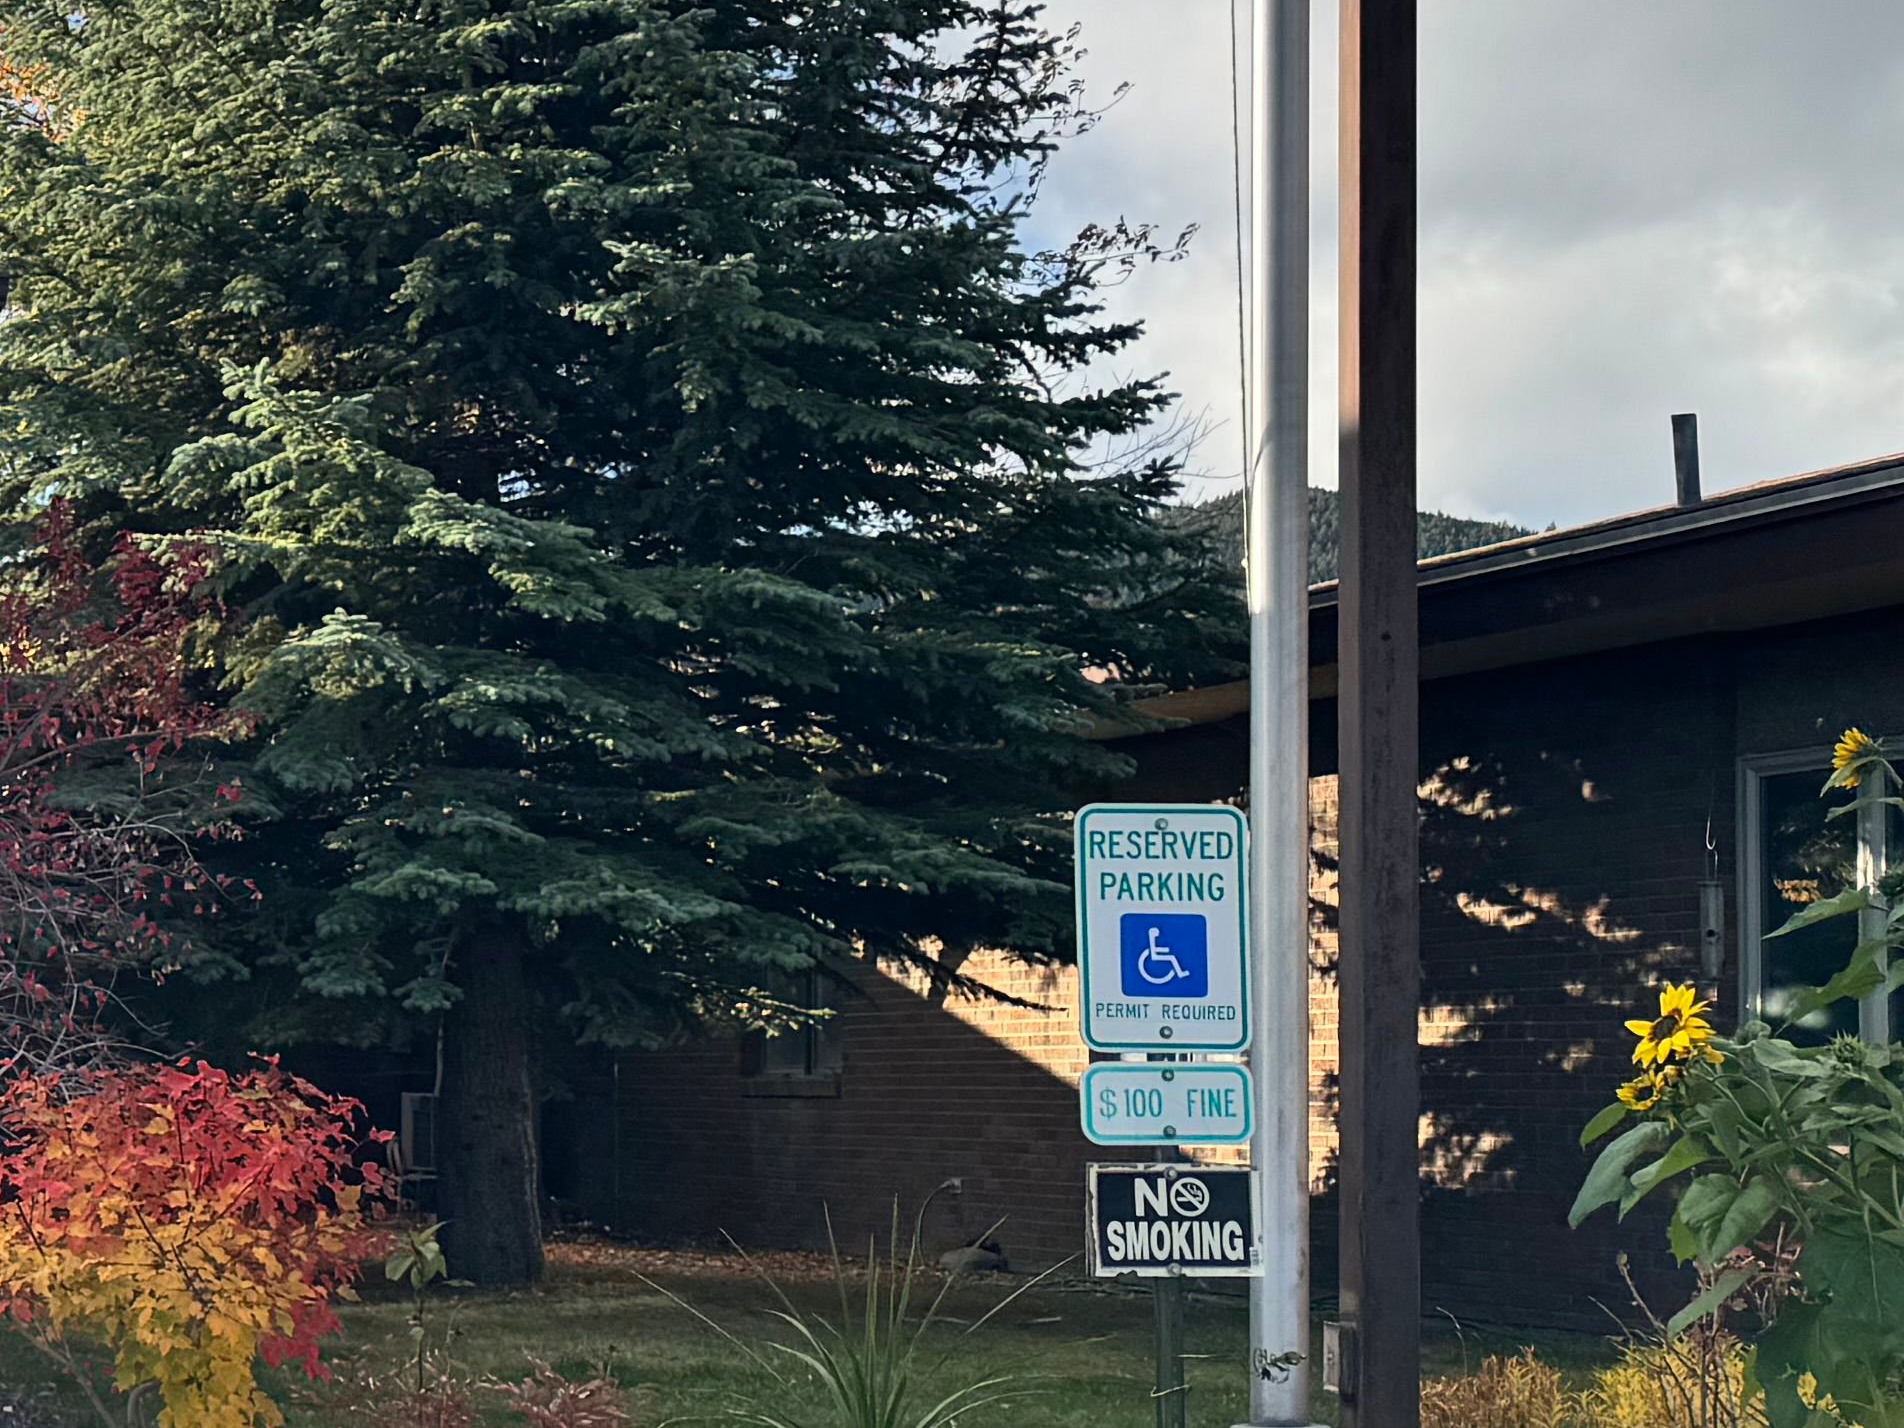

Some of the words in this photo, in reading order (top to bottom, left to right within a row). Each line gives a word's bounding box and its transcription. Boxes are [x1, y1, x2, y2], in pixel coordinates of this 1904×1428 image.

[1088, 829, 1234, 861] RESERVED
[1099, 872, 1226, 902] PARKING
[1095, 1002, 1150, 1020] PERMIT
[1161, 1003, 1237, 1021] REQUIRED
[1099, 1088, 1163, 1119] $100
[1187, 1089, 1237, 1118] FINE
[1106, 1221, 1244, 1262] SMOKING
